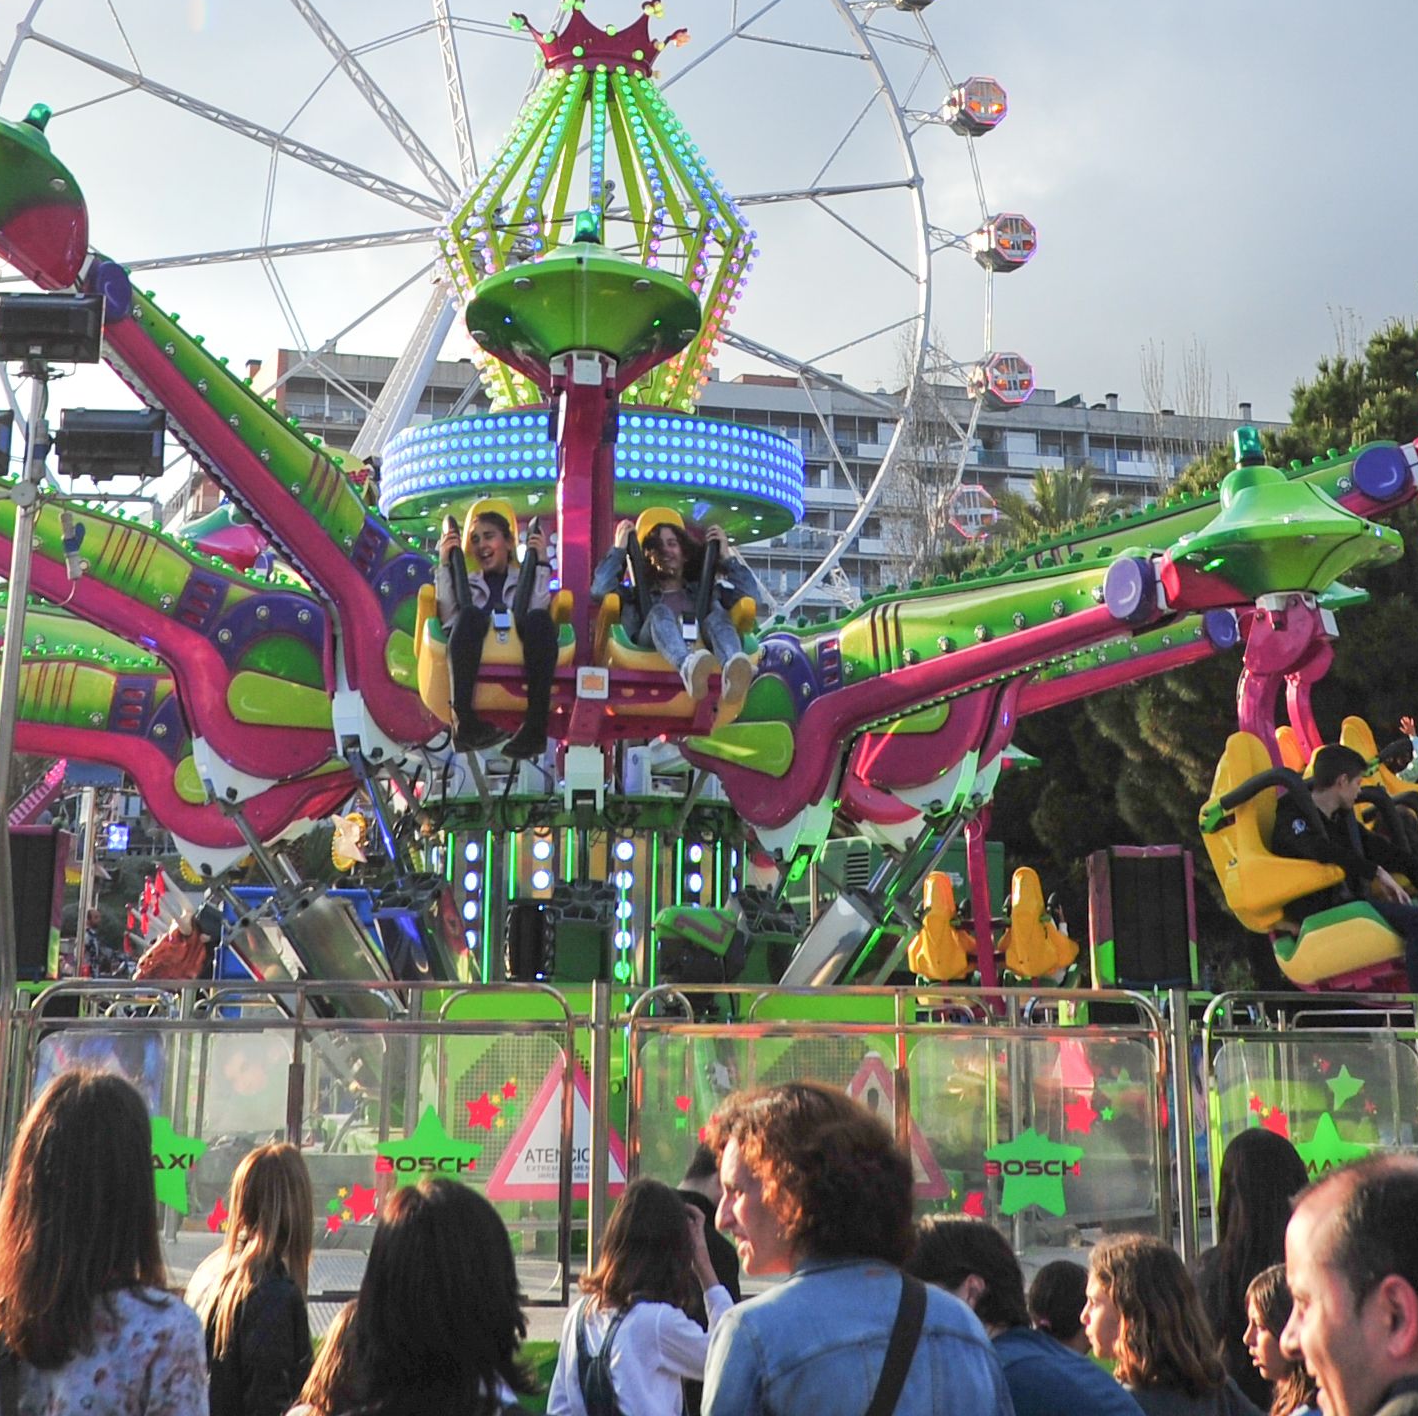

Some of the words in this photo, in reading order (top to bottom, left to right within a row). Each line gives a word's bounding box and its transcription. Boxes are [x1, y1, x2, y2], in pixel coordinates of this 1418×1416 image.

[152, 1153, 197, 1171] AXI
[375, 1155, 475, 1173] BOSCH
[984, 1160, 1081, 1176] BOSCH
